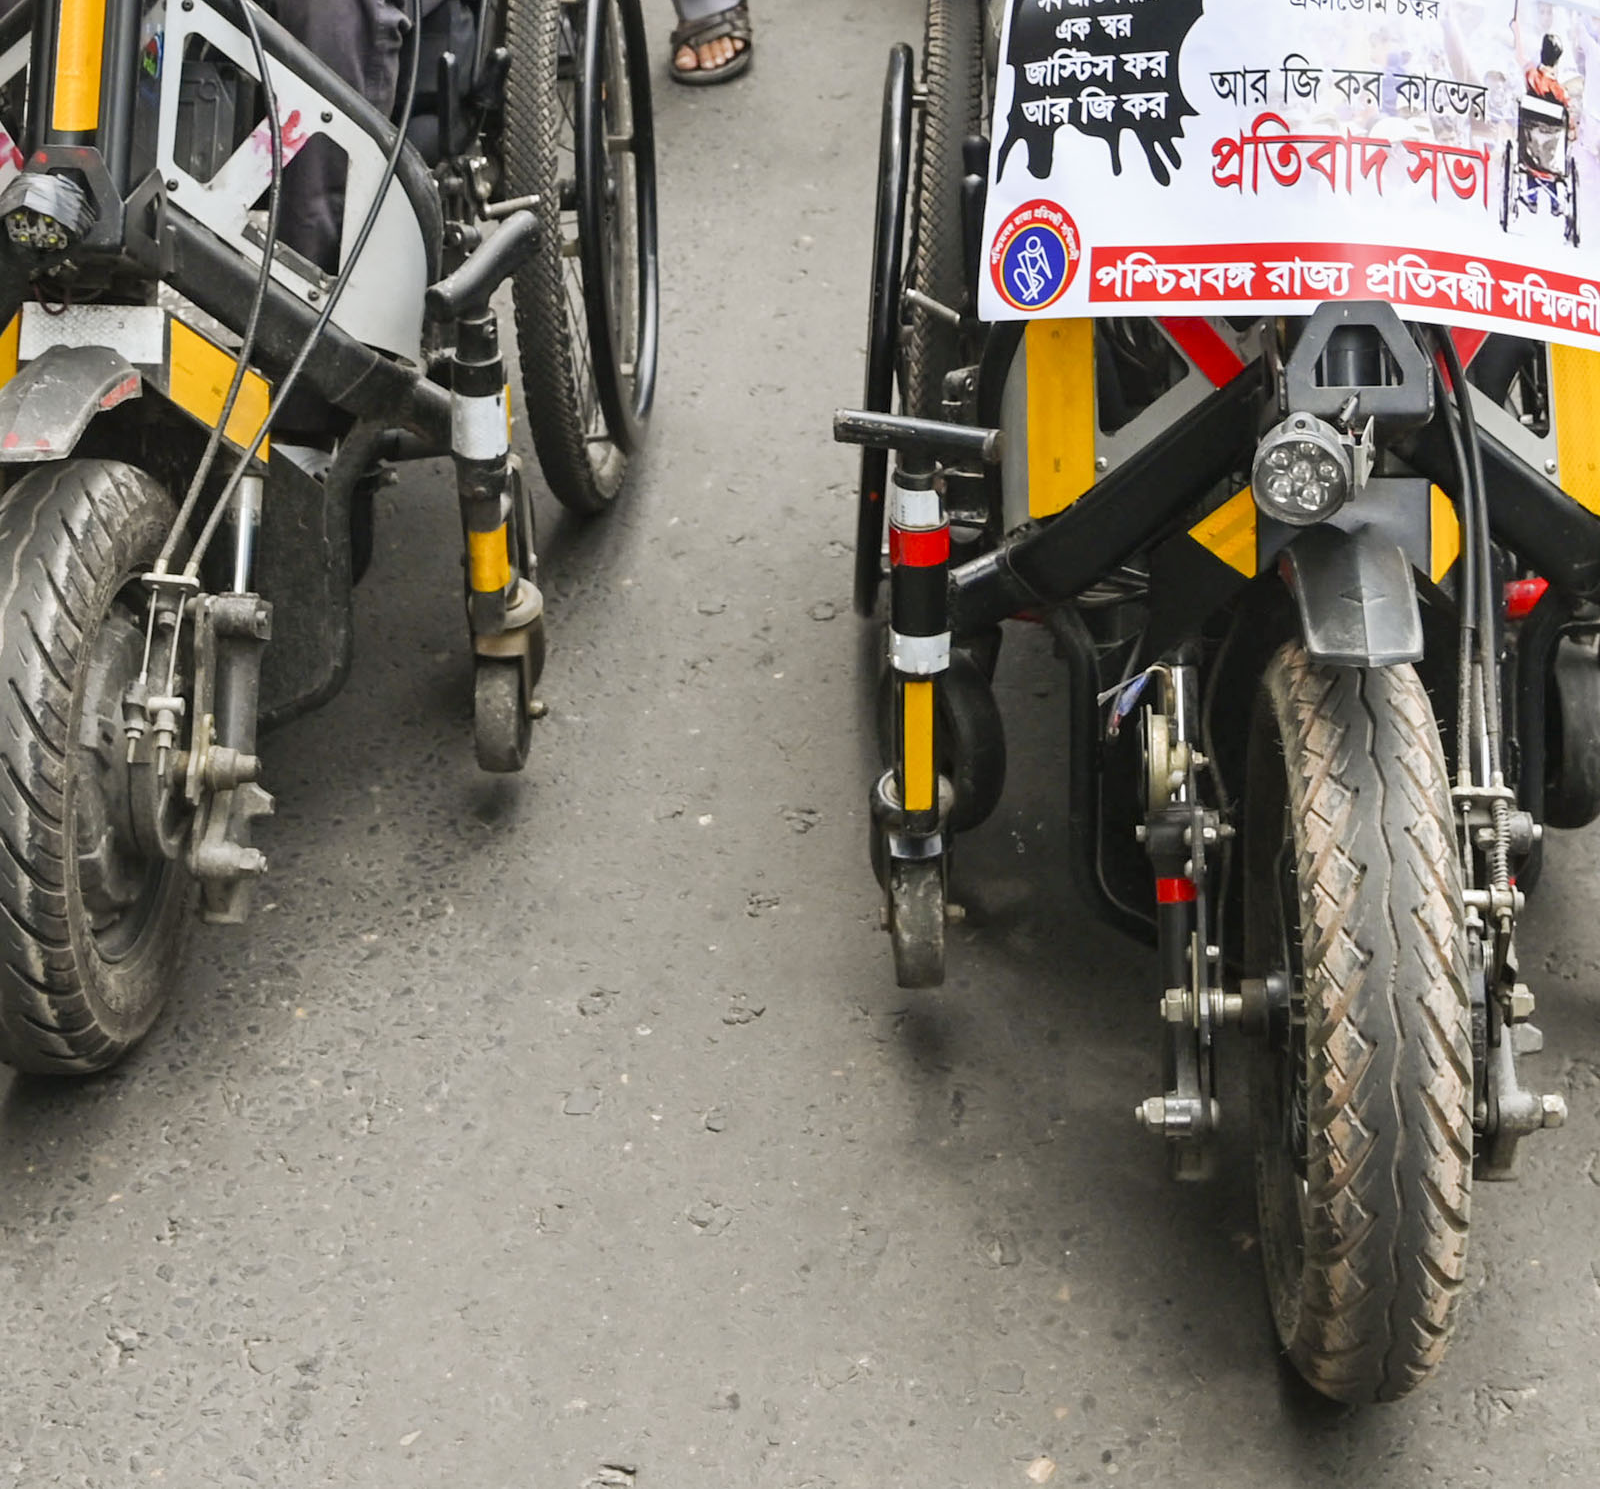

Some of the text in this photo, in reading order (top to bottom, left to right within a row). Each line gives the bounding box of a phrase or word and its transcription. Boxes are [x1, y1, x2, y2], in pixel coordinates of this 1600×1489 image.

[1055, 13, 1134, 42] এক স্বর
[1023, 47, 1171, 87] জাস্টিস ফর
[1209, 64, 1271, 107] আর
[1279, 52, 1324, 105] জি
[1331, 68, 1385, 108] কর
[1020, 85, 1170, 127] আর জি কর
[1210, 111, 1490, 211] প্রতিবাদ সভা
[1095, 251, 1256, 298] পশ্চিমবঙ্গ
[1262, 254, 1354, 298] রাজ্য
[1365, 253, 1496, 312] প্রতিবন্ধী
